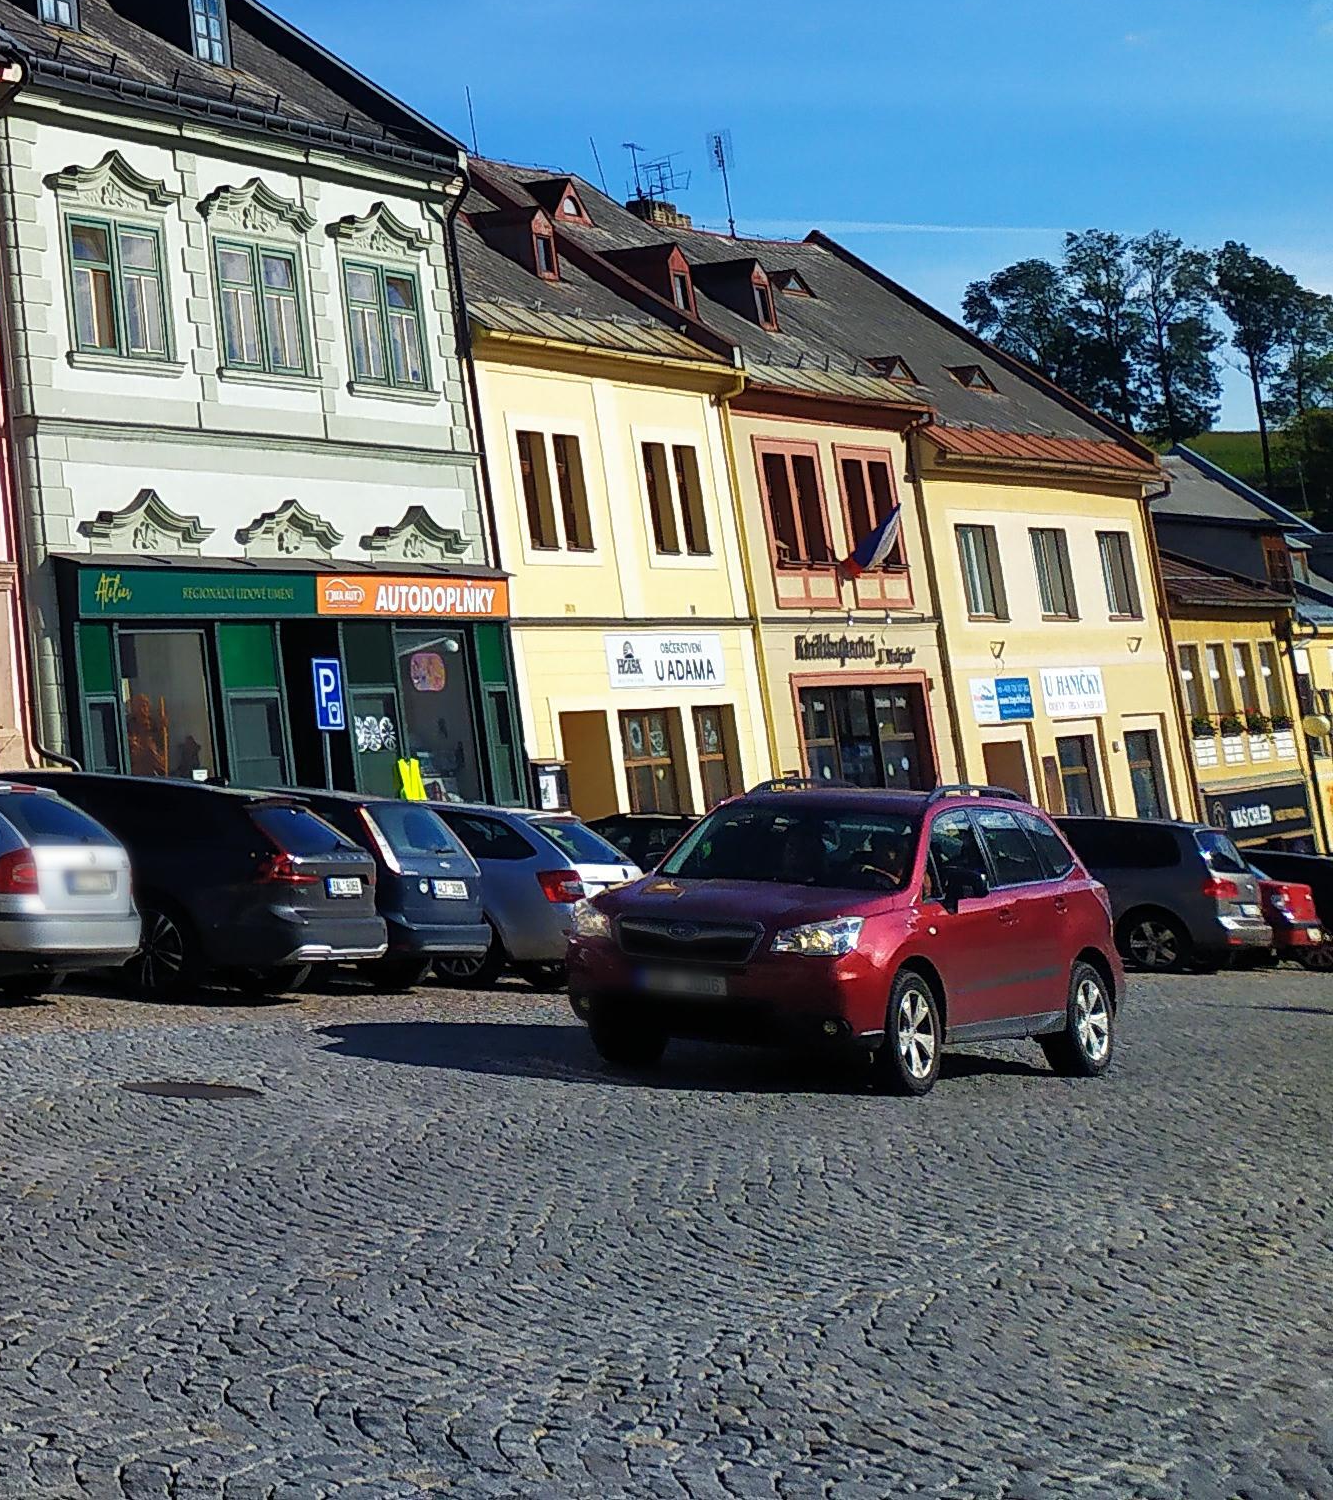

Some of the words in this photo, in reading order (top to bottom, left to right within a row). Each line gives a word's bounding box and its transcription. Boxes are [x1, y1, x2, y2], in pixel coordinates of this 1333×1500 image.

[374, 580, 495, 613] AUTODOPLŇKY
[660, 640, 702, 654] OBČERSTVENÍ
[655, 660, 665, 681] U
[667, 659, 716, 681] ADAMA
[1043, 675, 1053, 697] U
[1055, 669, 1101, 696] HANIČKY
